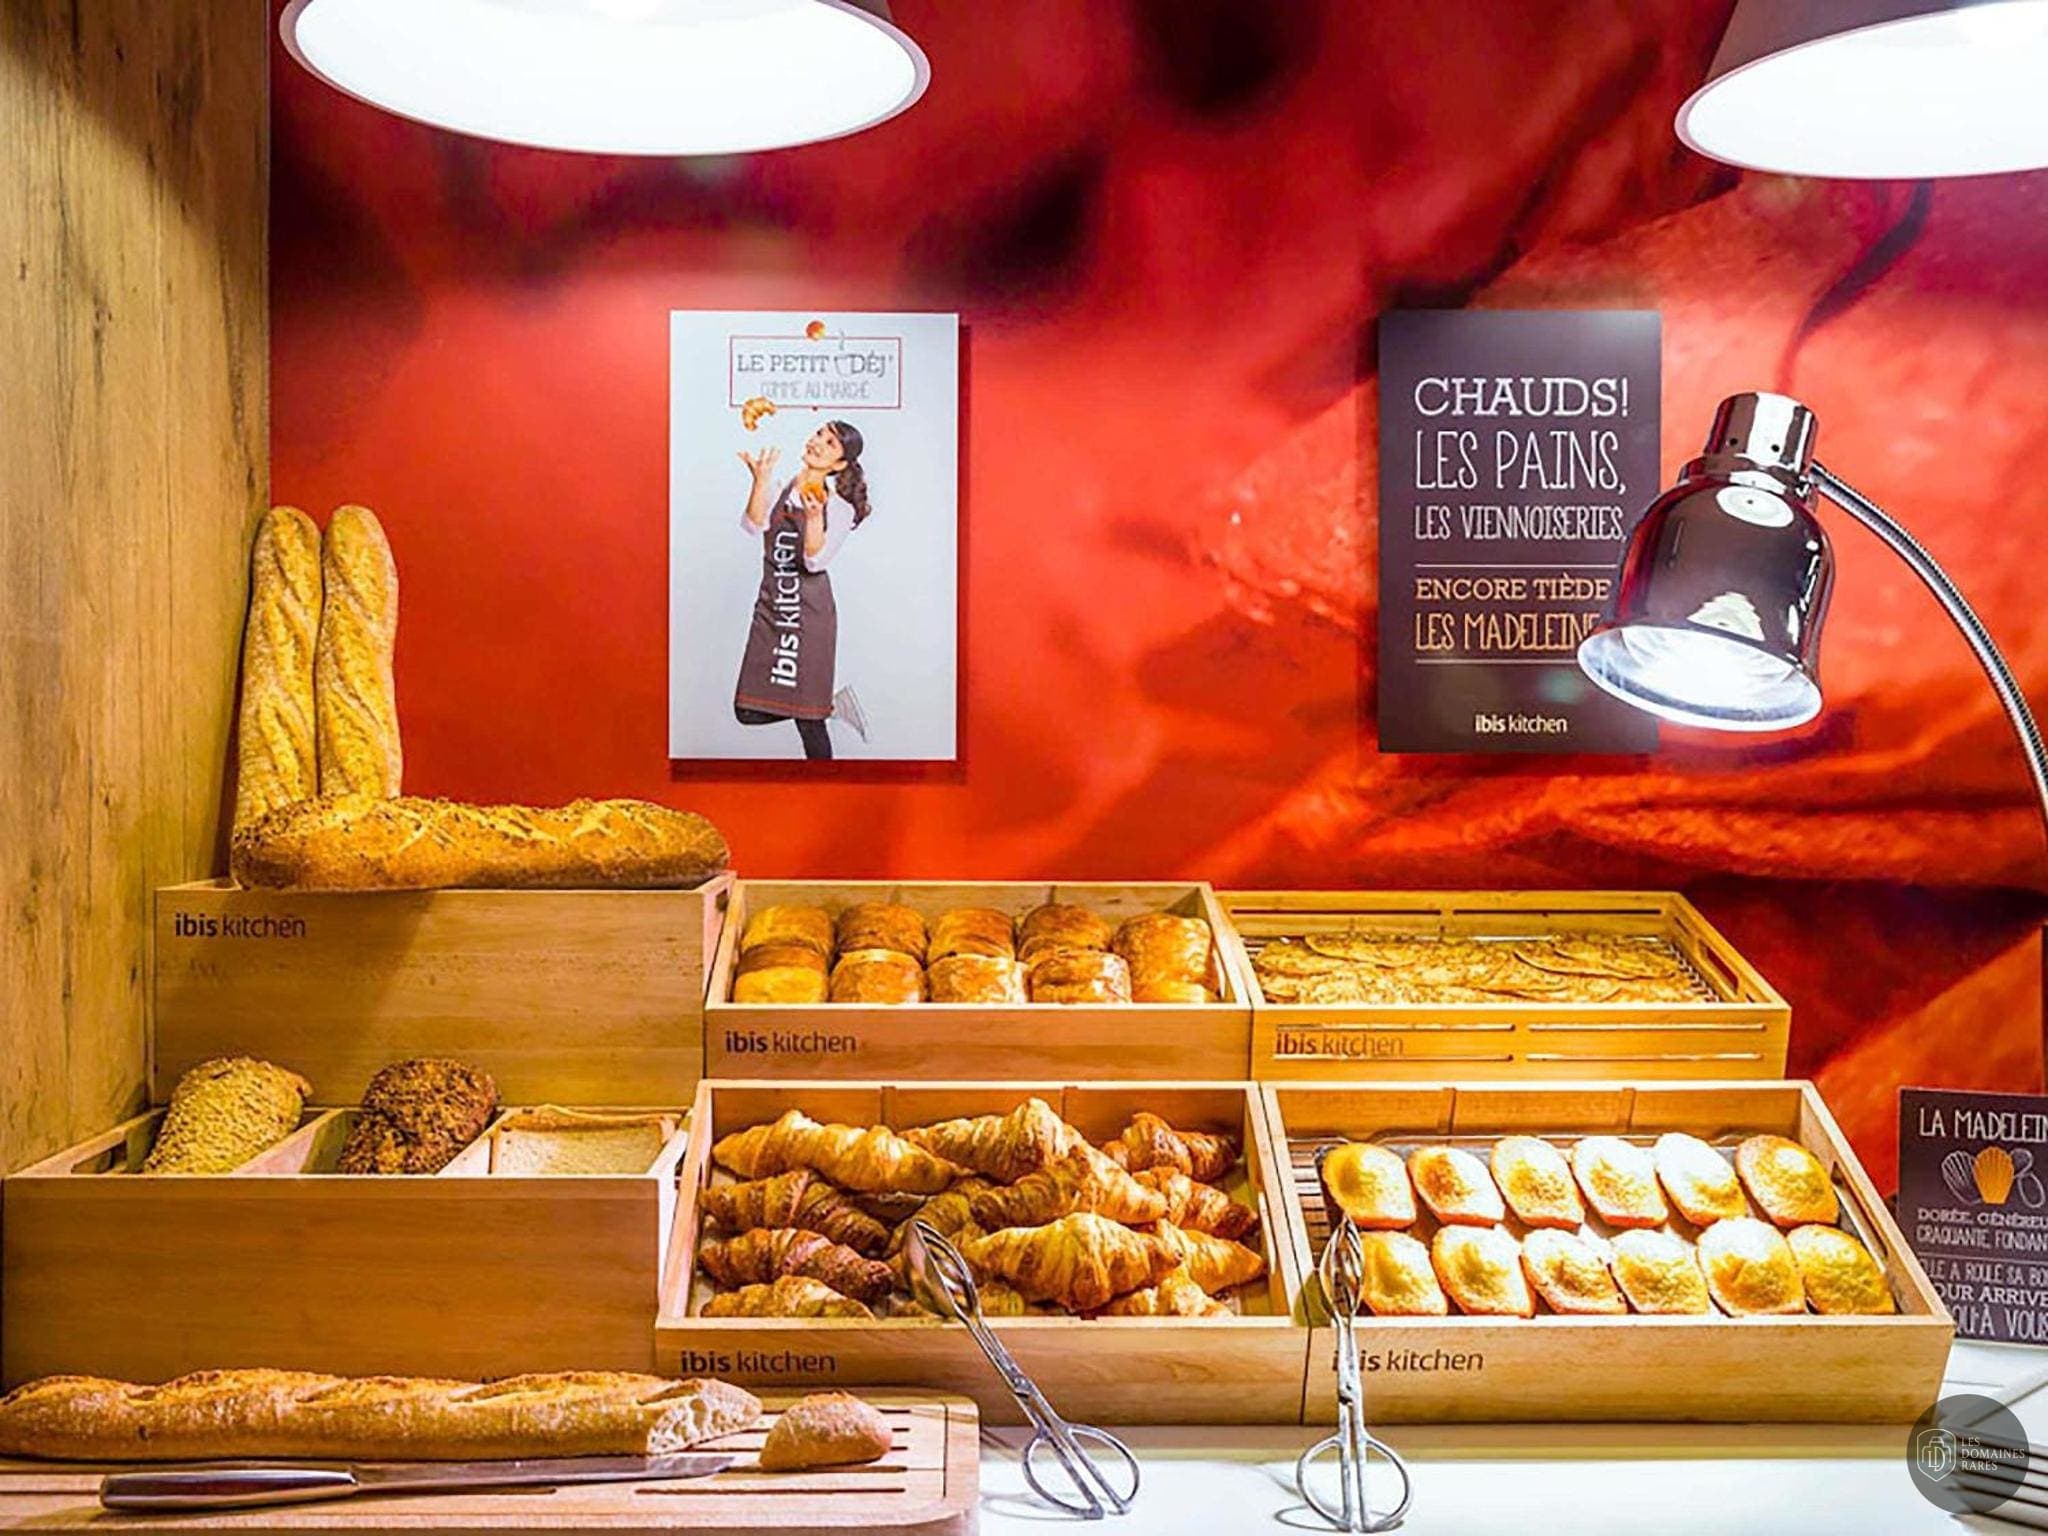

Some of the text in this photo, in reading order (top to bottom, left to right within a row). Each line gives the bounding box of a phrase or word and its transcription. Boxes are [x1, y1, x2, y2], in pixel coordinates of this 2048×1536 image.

[737, 354, 764, 372] LE
[770, 354, 829, 372] PETIT
[1415, 377, 1628, 417] CHAUDS!
[1416, 430, 1626, 494] LES PAINS,
[1415, 505, 1627, 543] LES VIENNOISERIES,
[1415, 579, 1526, 600] ENCORE
[771, 531, 800, 687] ibis kitchen
[1415, 613, 1455, 650] LES
[1475, 714, 1567, 733] ibis kitchen
[175, 912, 306, 938] ibis kitchen
[725, 1031, 857, 1053] ibis kitchen
[1276, 1033, 1404, 1056] ibis kitchen
[1919, 1108, 1945, 1137] LA
[1950, 1261, 1960, 1281] A
[1933, 1282, 1974, 1301] OUR
[681, 1350, 836, 1373] ibis kitchen
[1332, 1350, 1484, 1372] iis kitchen
